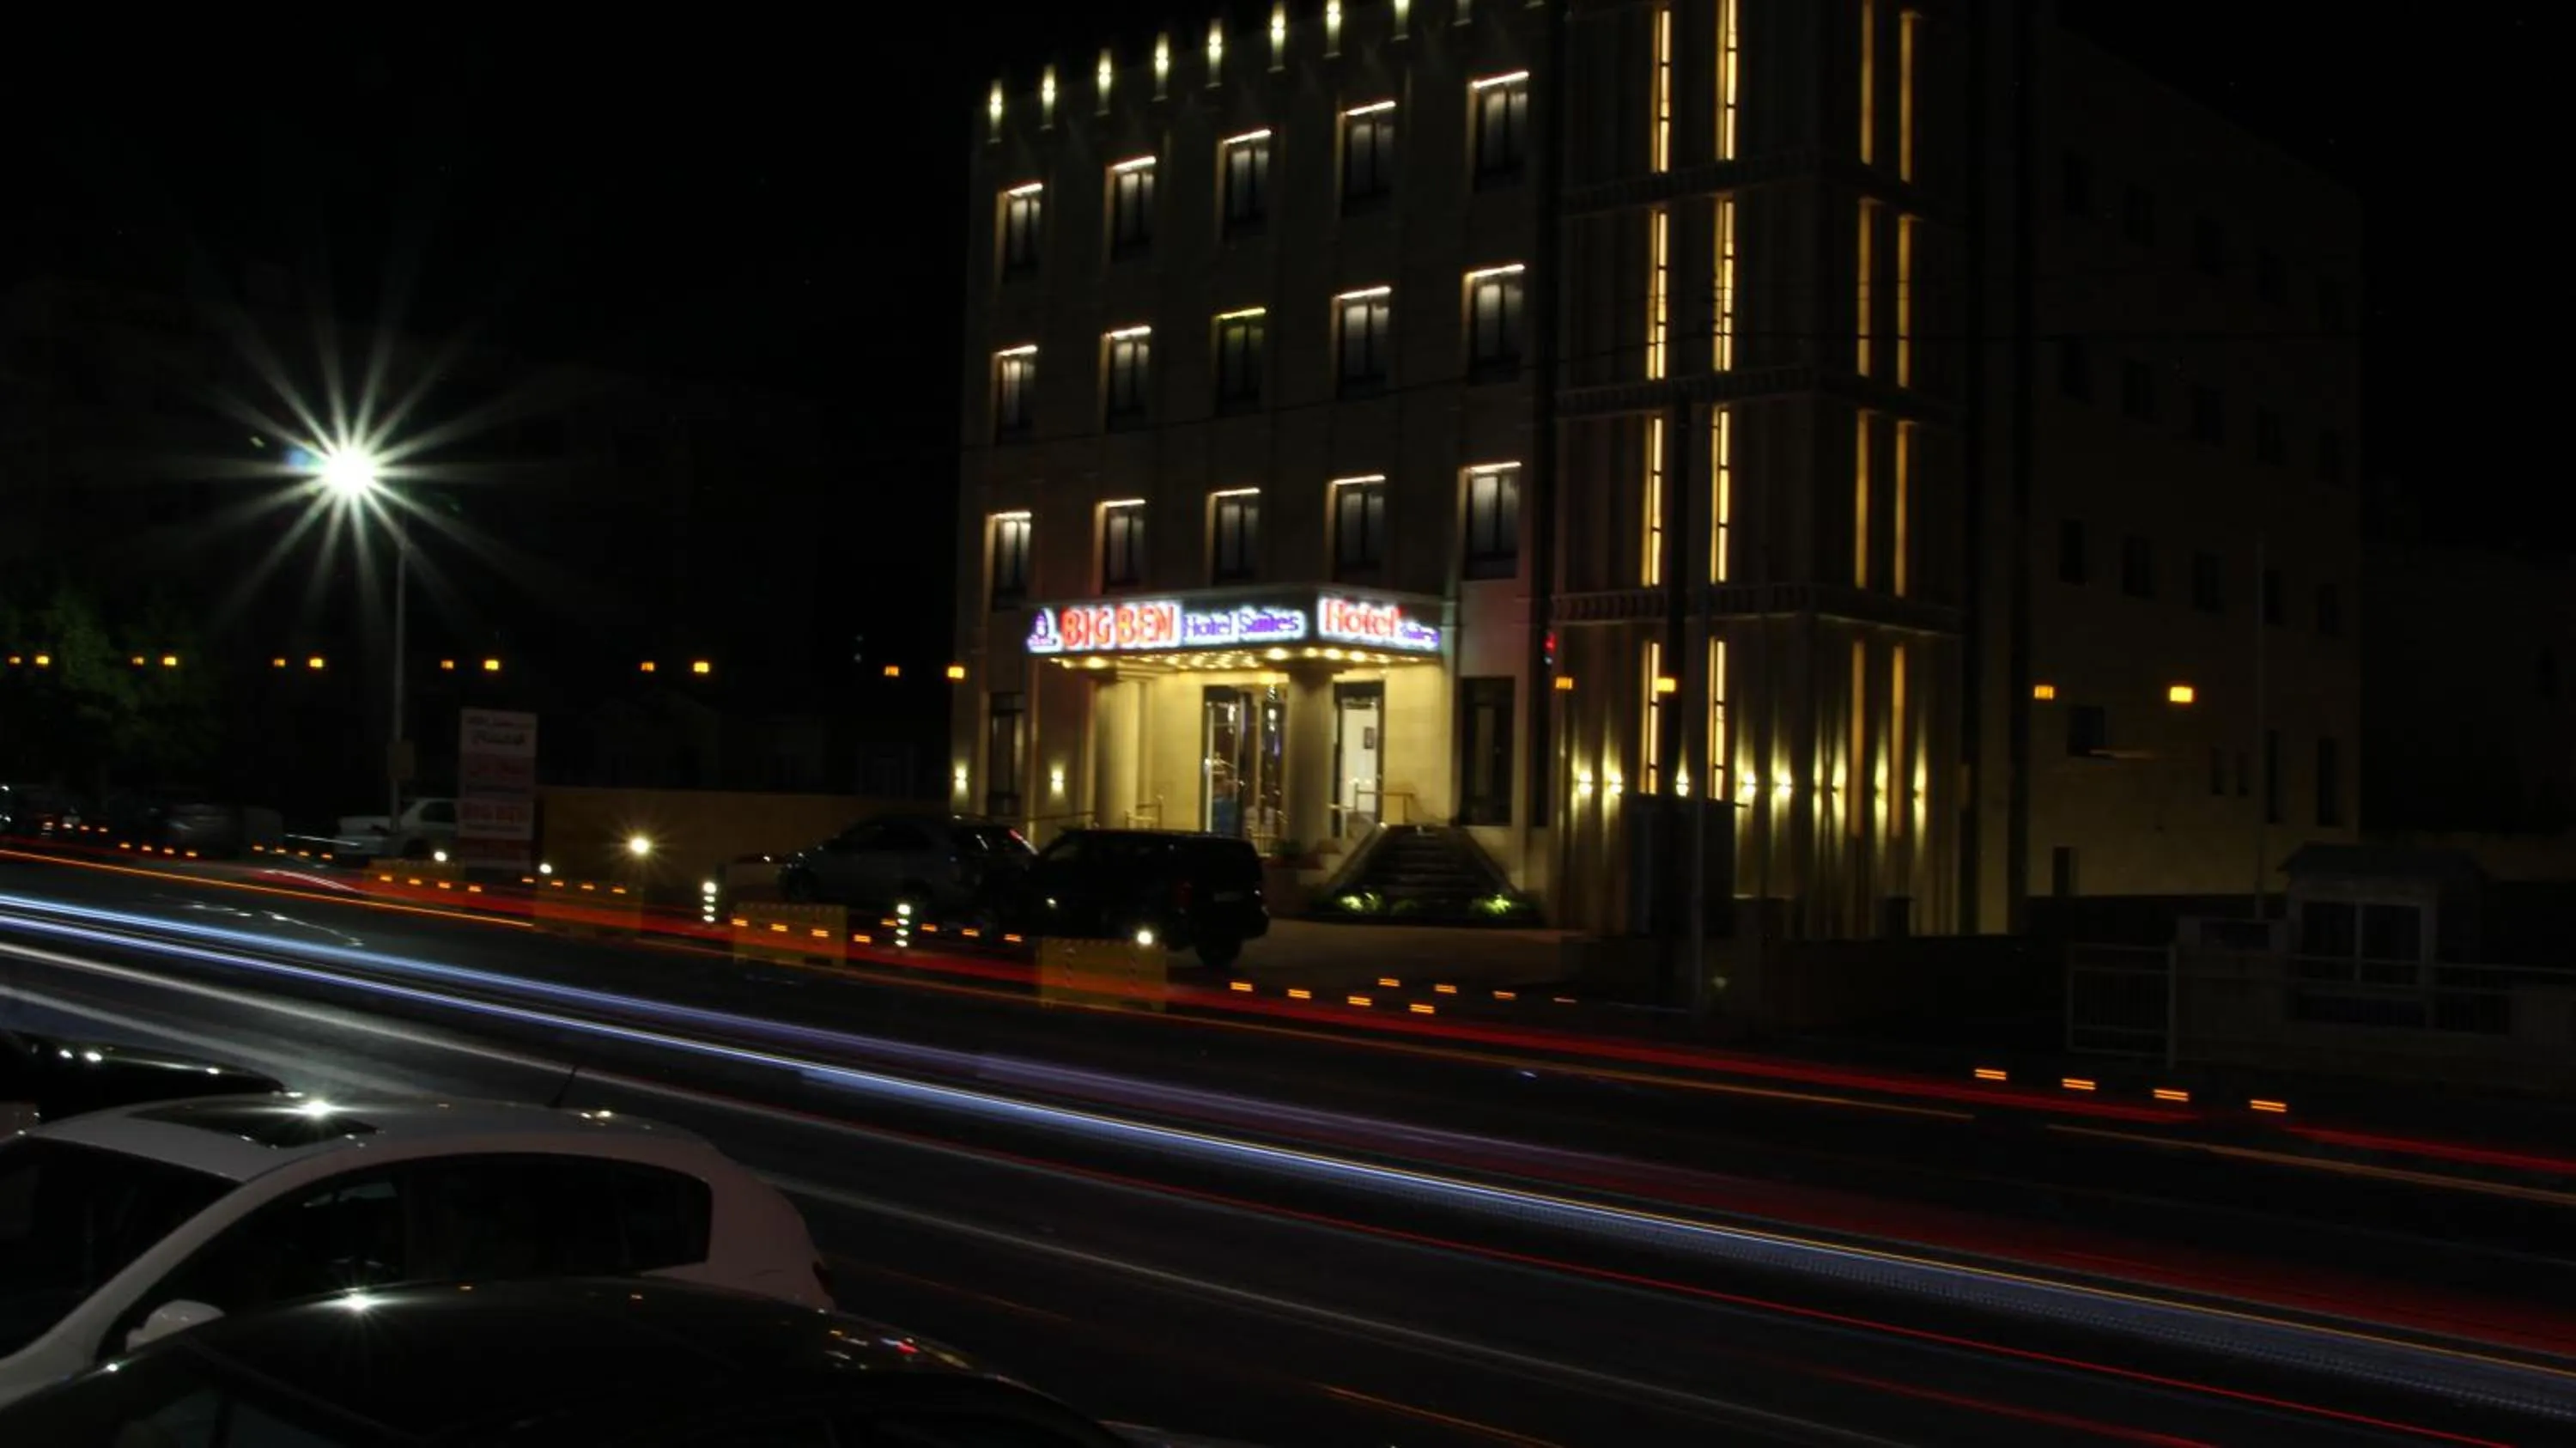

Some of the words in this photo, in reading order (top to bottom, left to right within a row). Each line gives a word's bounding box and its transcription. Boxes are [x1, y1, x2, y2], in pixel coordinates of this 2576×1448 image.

[1060, 605, 1113, 647] BIG
[1115, 603, 1175, 643] BEN
[1182, 611, 1232, 637] Hotel
[1323, 600, 1398, 637] Hotel
